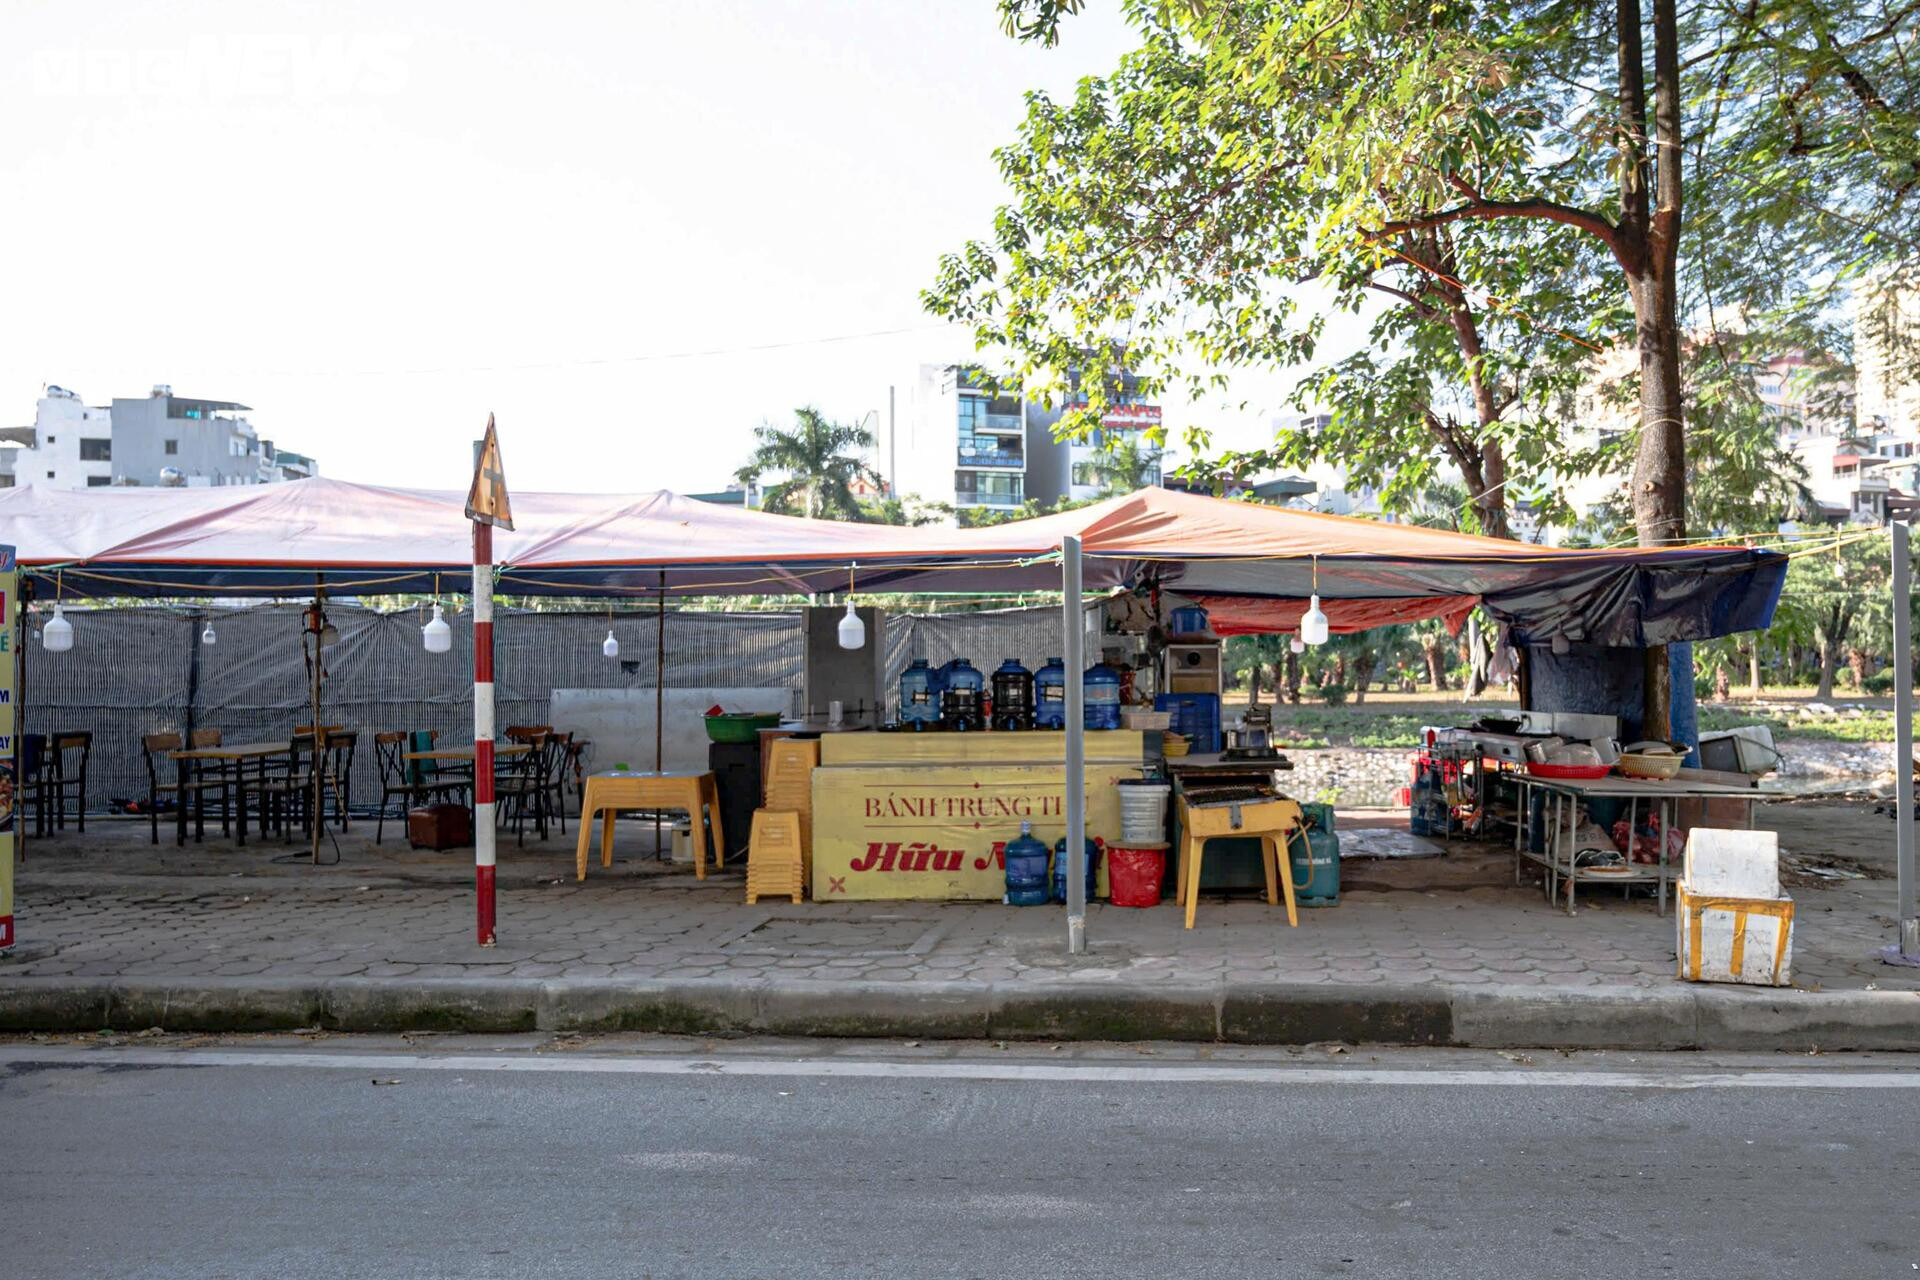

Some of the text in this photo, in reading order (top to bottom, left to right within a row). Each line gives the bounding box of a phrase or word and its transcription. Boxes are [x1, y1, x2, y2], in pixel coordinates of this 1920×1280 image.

[865, 792, 937, 817] BÁNH
[942, 796, 1031, 817] TRUNG
[850, 842, 965, 872] Hữu
